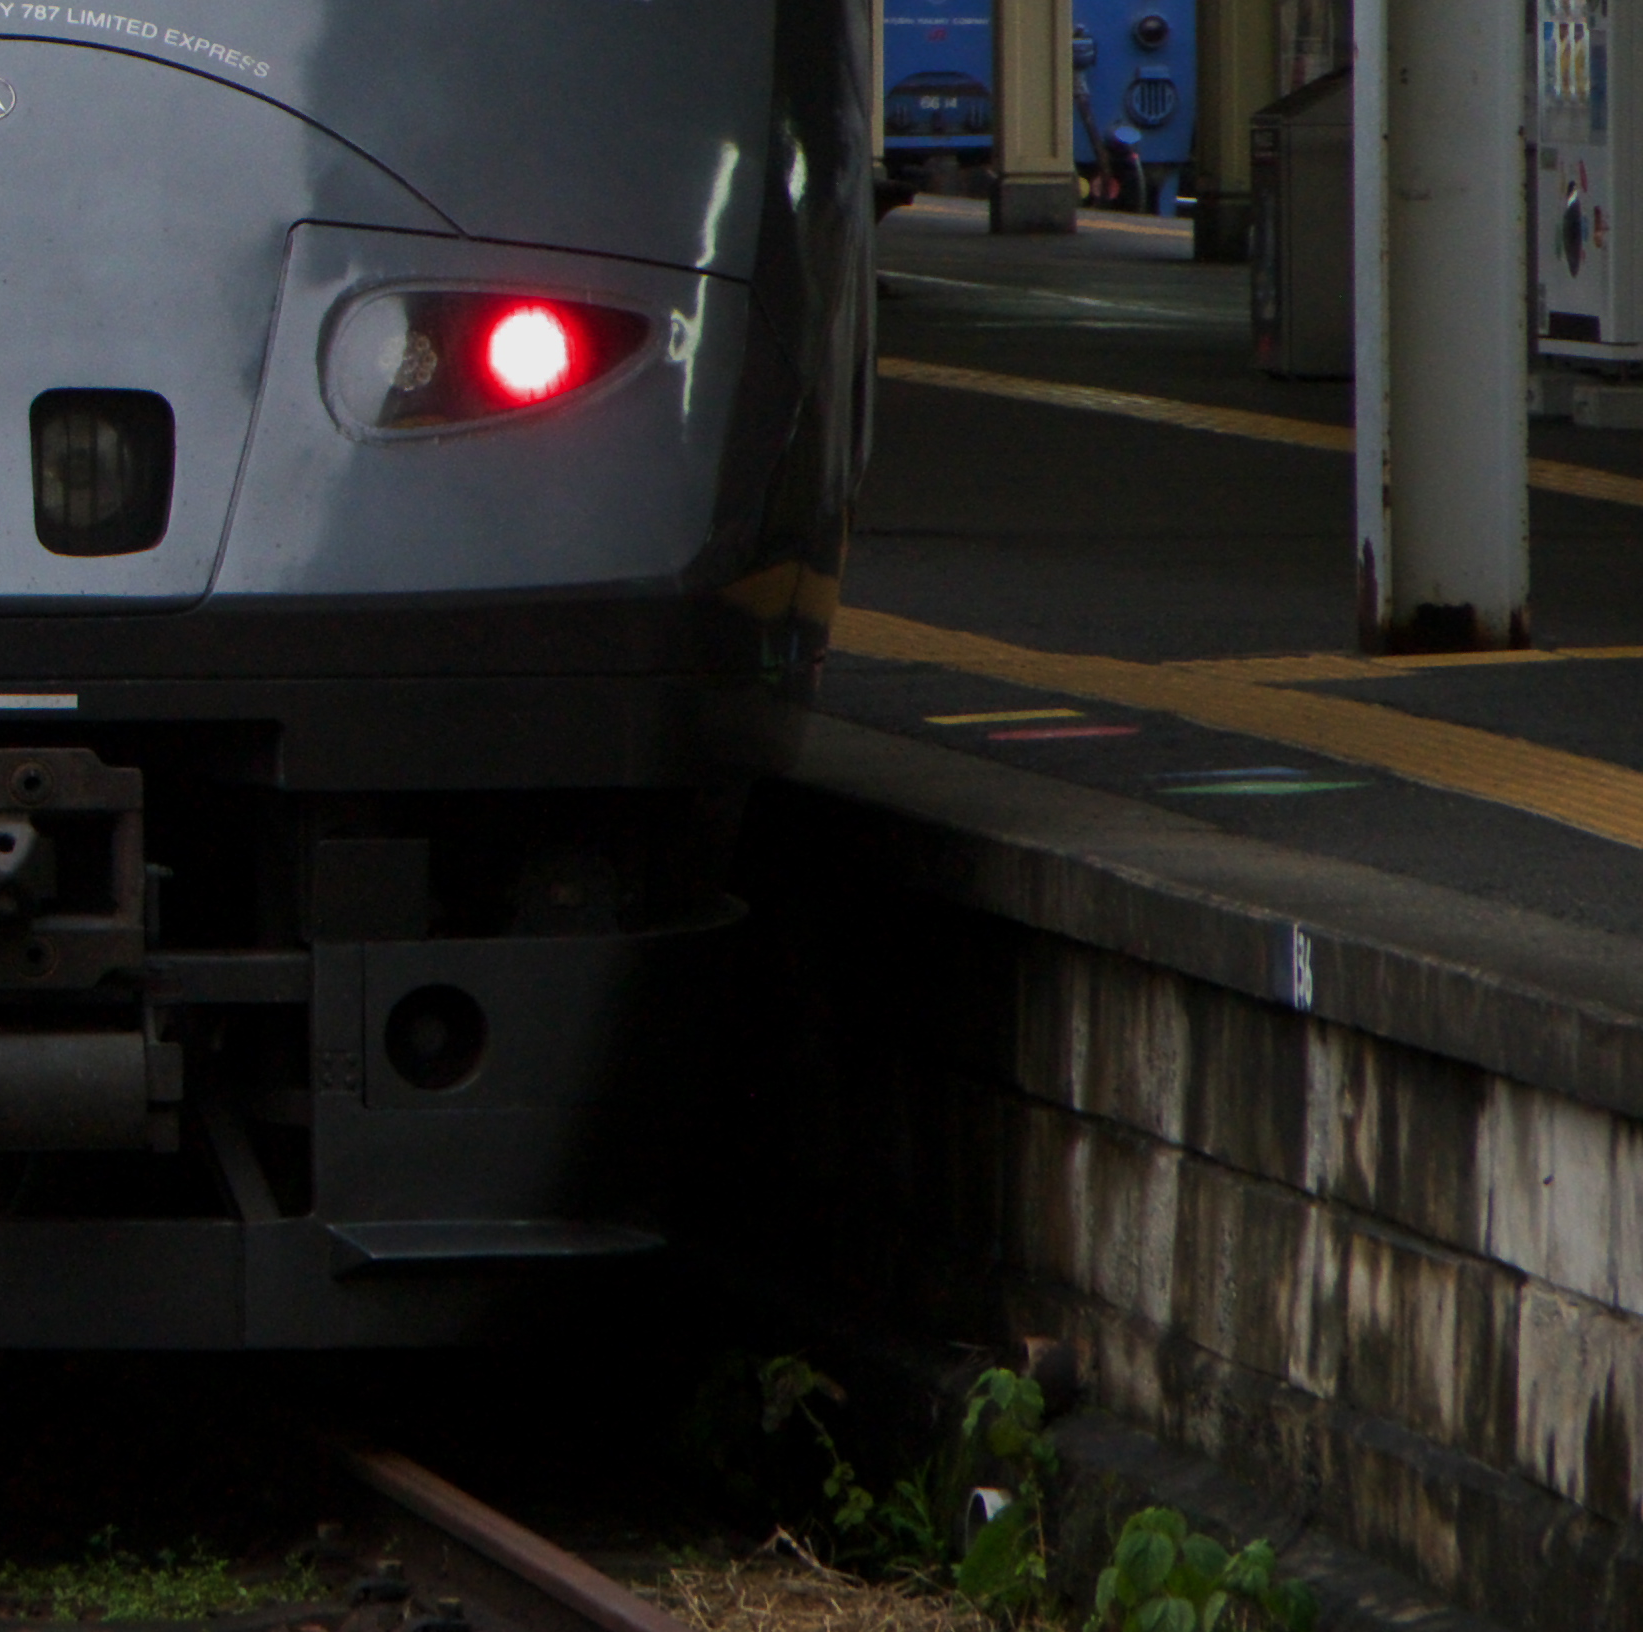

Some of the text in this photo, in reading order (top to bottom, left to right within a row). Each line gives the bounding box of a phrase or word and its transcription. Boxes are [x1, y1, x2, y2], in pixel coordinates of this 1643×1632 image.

[21, 4, 62, 21] 787
[67, 8, 158, 39] LIMITED
[164, 29, 271, 78] EXPRESS
